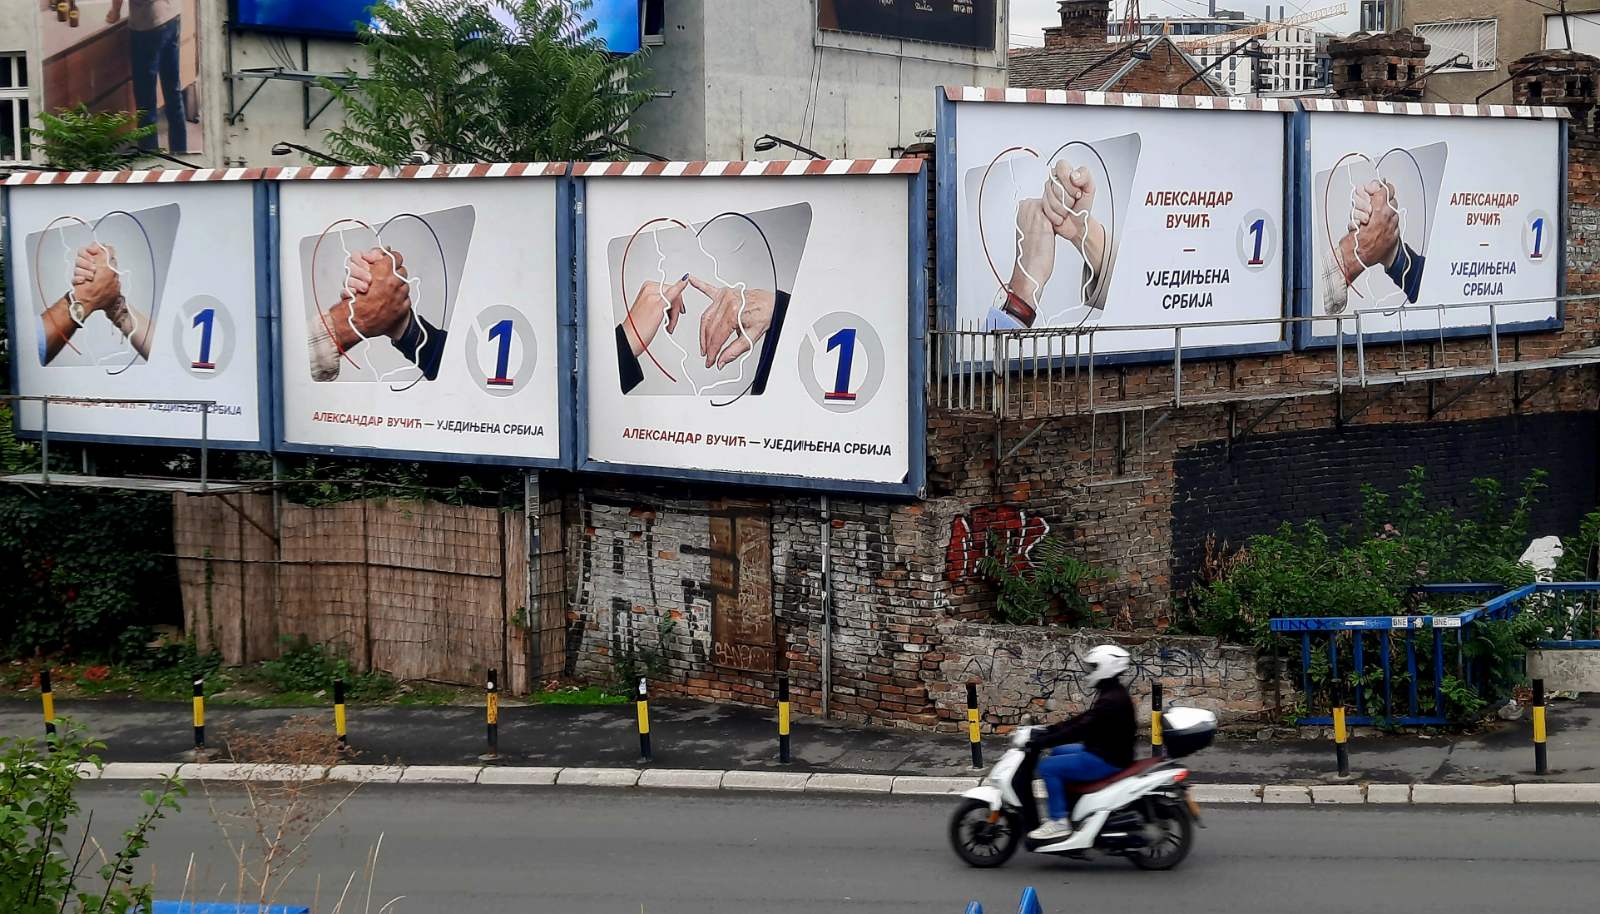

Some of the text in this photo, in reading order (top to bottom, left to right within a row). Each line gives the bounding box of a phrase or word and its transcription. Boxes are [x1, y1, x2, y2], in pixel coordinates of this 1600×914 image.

[1145, 191, 1233, 208] АЛЕКСАНДАР
[1450, 192, 1520, 208] АЛЕКСАНДАР
[1166, 214, 1210, 229] ВУЧИЋ
[1466, 213, 1501, 226] ВУЧИЋ
[1247, 219, 1265, 265] 1
[1530, 218, 1544, 258] 1
[1146, 269, 1230, 288] УЈЕДИЊЕНА
[1450, 261, 1517, 278] УЈЕДИЊЕНА
[1463, 282, 1504, 296] СРБИЈА
[1162, 292, 1213, 310] СРБИЈА
[191, 308, 215, 369] 1
[487, 319, 514, 386] 1
[824, 328, 857, 401] 1
[206, 404, 242, 416] СРБИЈА
[312, 411, 383, 427] АЛЕКСАНДАР
[387, 417, 422, 429] ВУЧИЋ
[437, 419, 501, 434] УЈЕДИЊЕНА
[503, 424, 544, 436] СРБИЈА
[622, 427, 702, 446] АЛЕКСАНДАР
[706, 434, 747, 448] ВУЧИЋ
[763, 438, 841, 453] УЈЕДИЊЕНА
[843, 442, 892, 456] СРБИЈА
